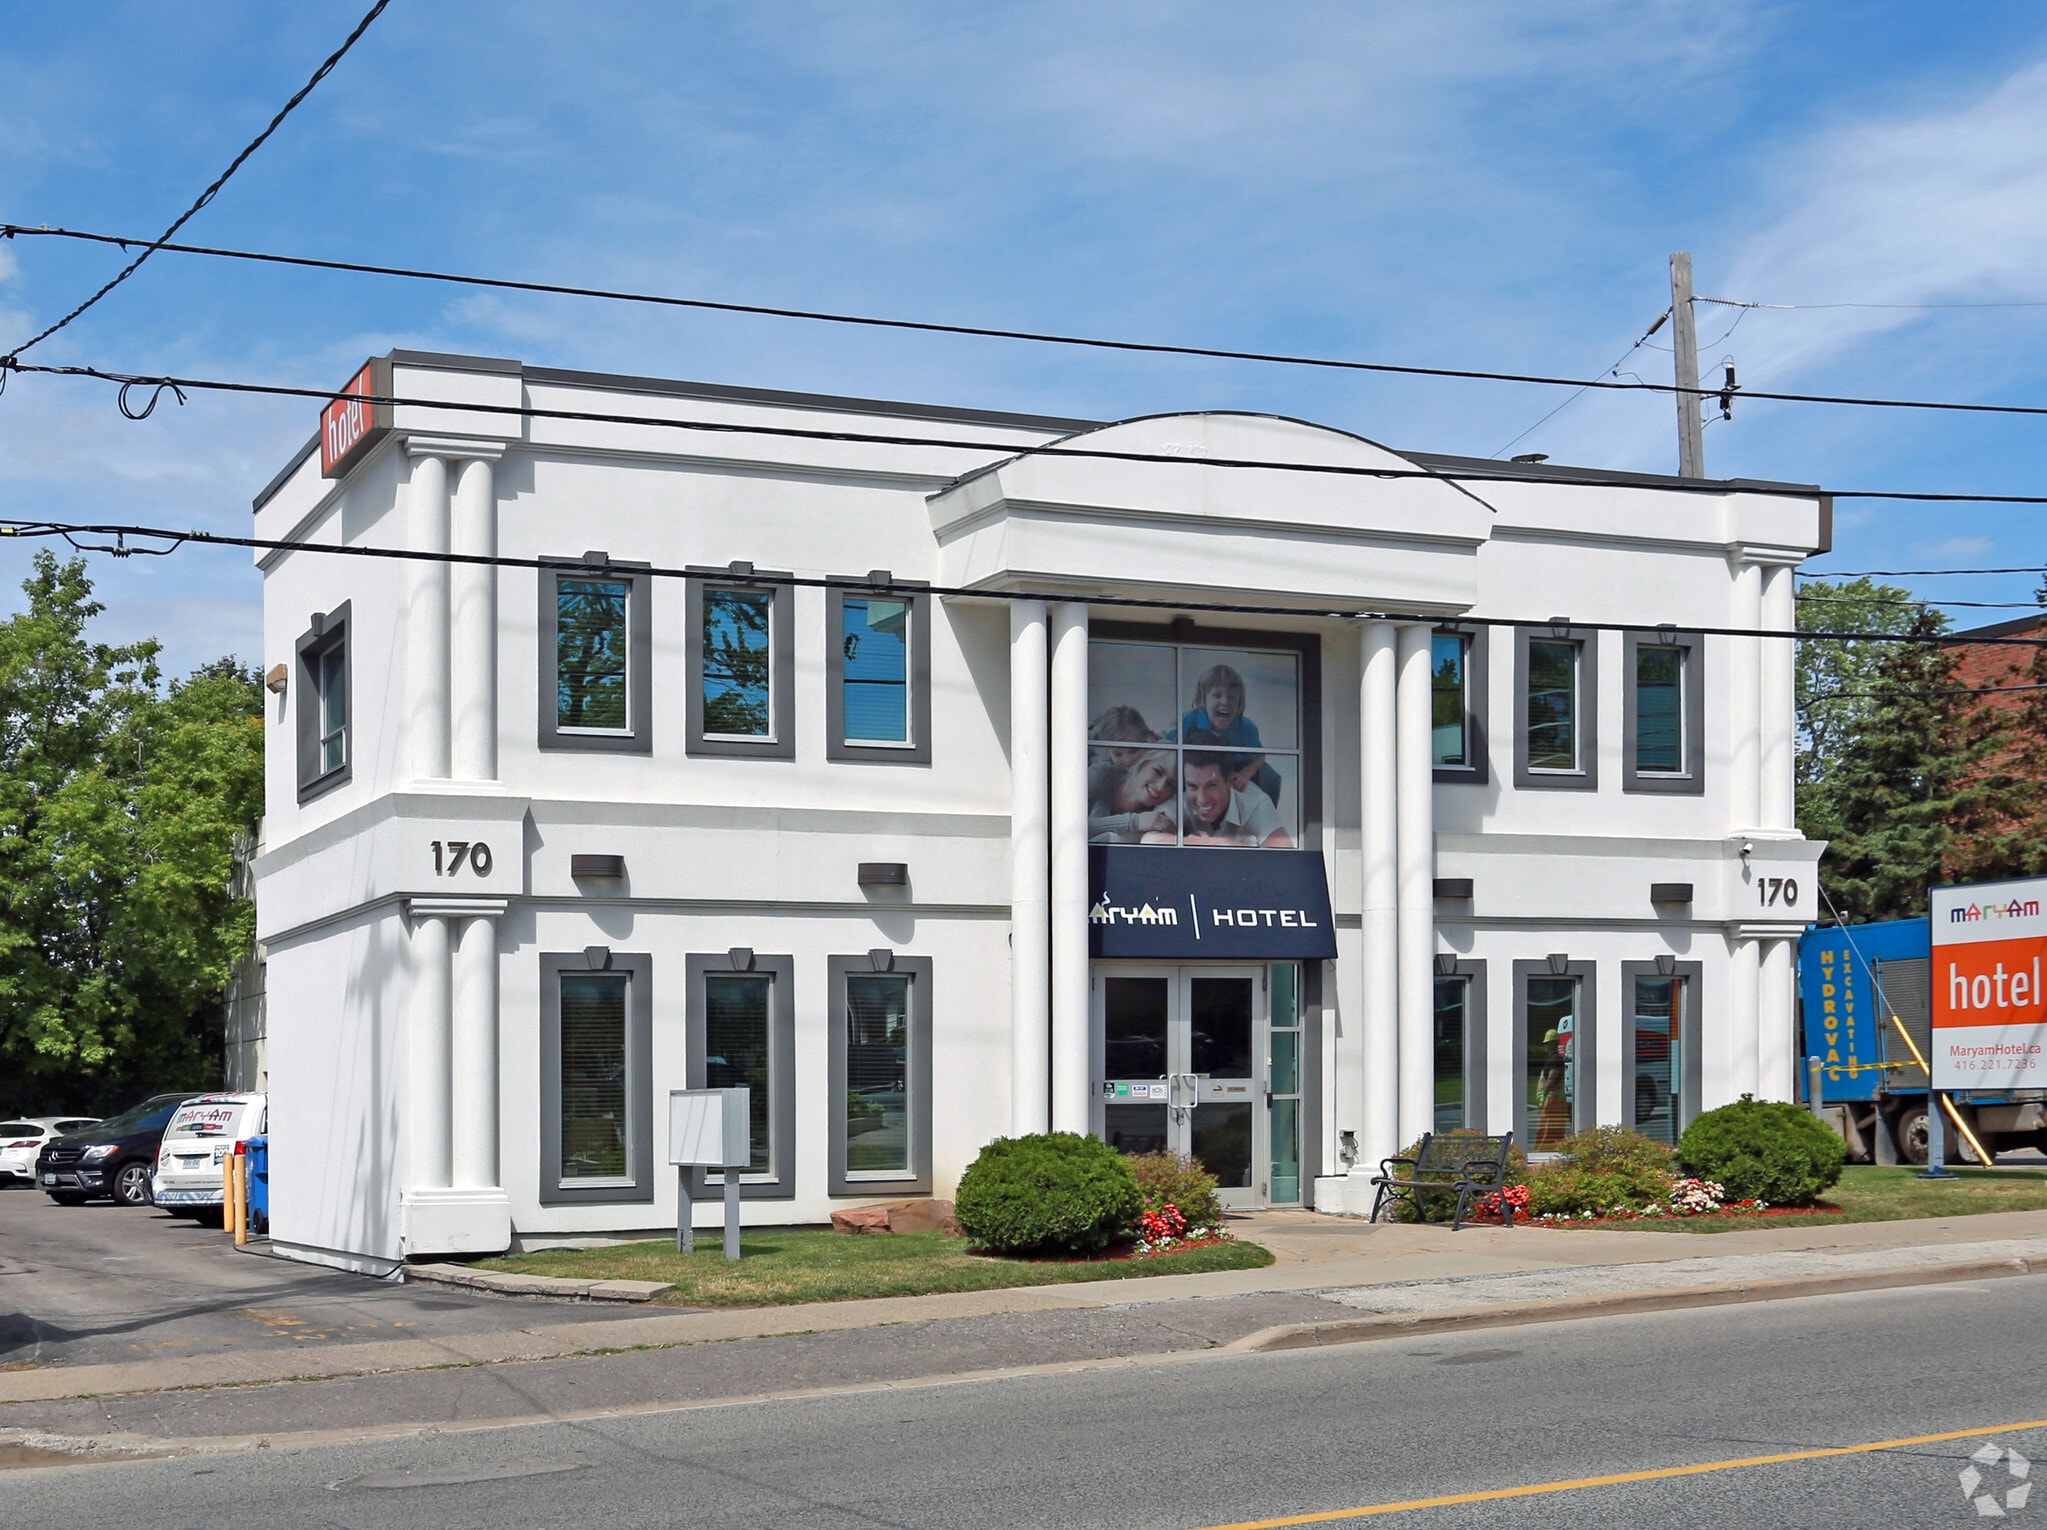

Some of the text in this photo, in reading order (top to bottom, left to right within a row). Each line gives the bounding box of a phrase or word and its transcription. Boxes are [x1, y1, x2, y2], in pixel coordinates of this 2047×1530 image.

[328, 372, 364, 463] hotel
[430, 840, 493, 876] 170
[1757, 877, 1798, 907] 170
[1212, 908, 1318, 928] HOTEL
[1949, 956, 2041, 1010] hotel
[1820, 950, 1840, 1082] HYDROVAC
[1843, 949, 1859, 1080] EXCAVATING
[1950, 1043, 2042, 1060] MaryamHotel.ca
[1954, 1058, 2037, 1071] 416.221.7236
